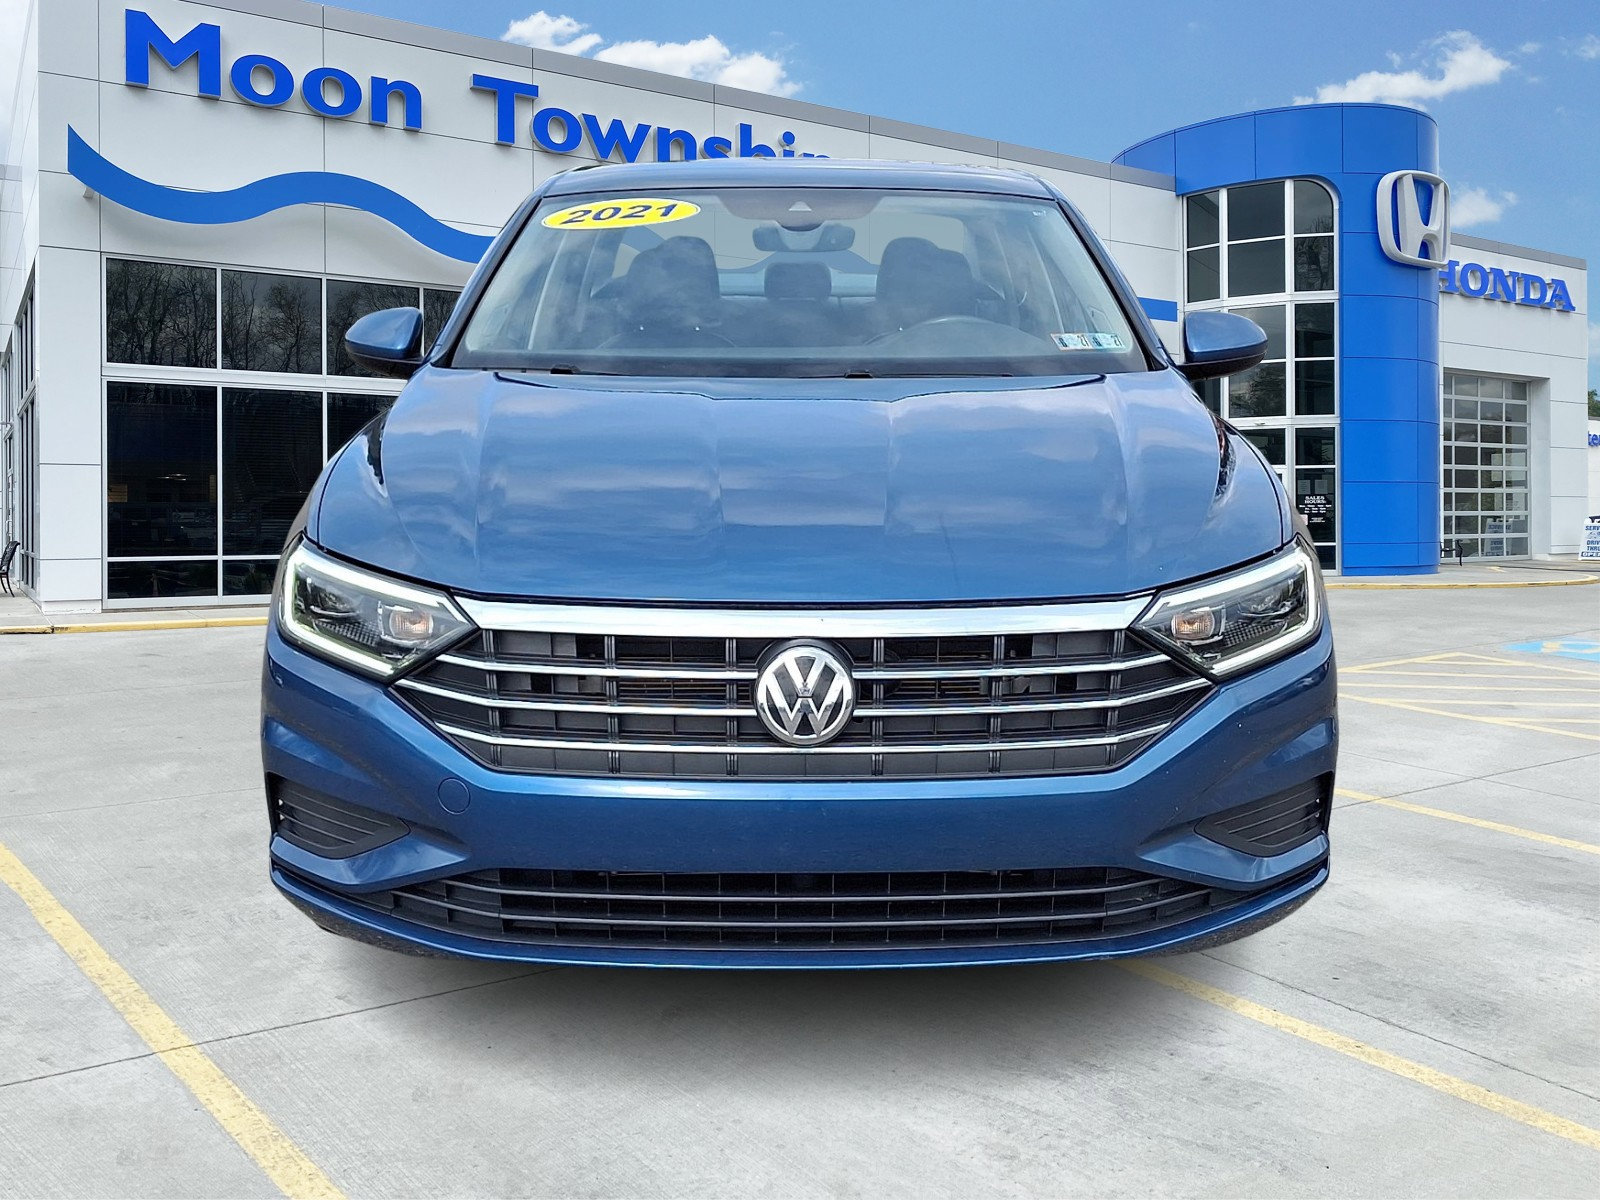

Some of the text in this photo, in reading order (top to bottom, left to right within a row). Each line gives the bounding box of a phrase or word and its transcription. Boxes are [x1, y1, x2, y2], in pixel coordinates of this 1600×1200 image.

[125, 9, 831, 164] Moon Townshi
[559, 203, 678, 225] 2021
